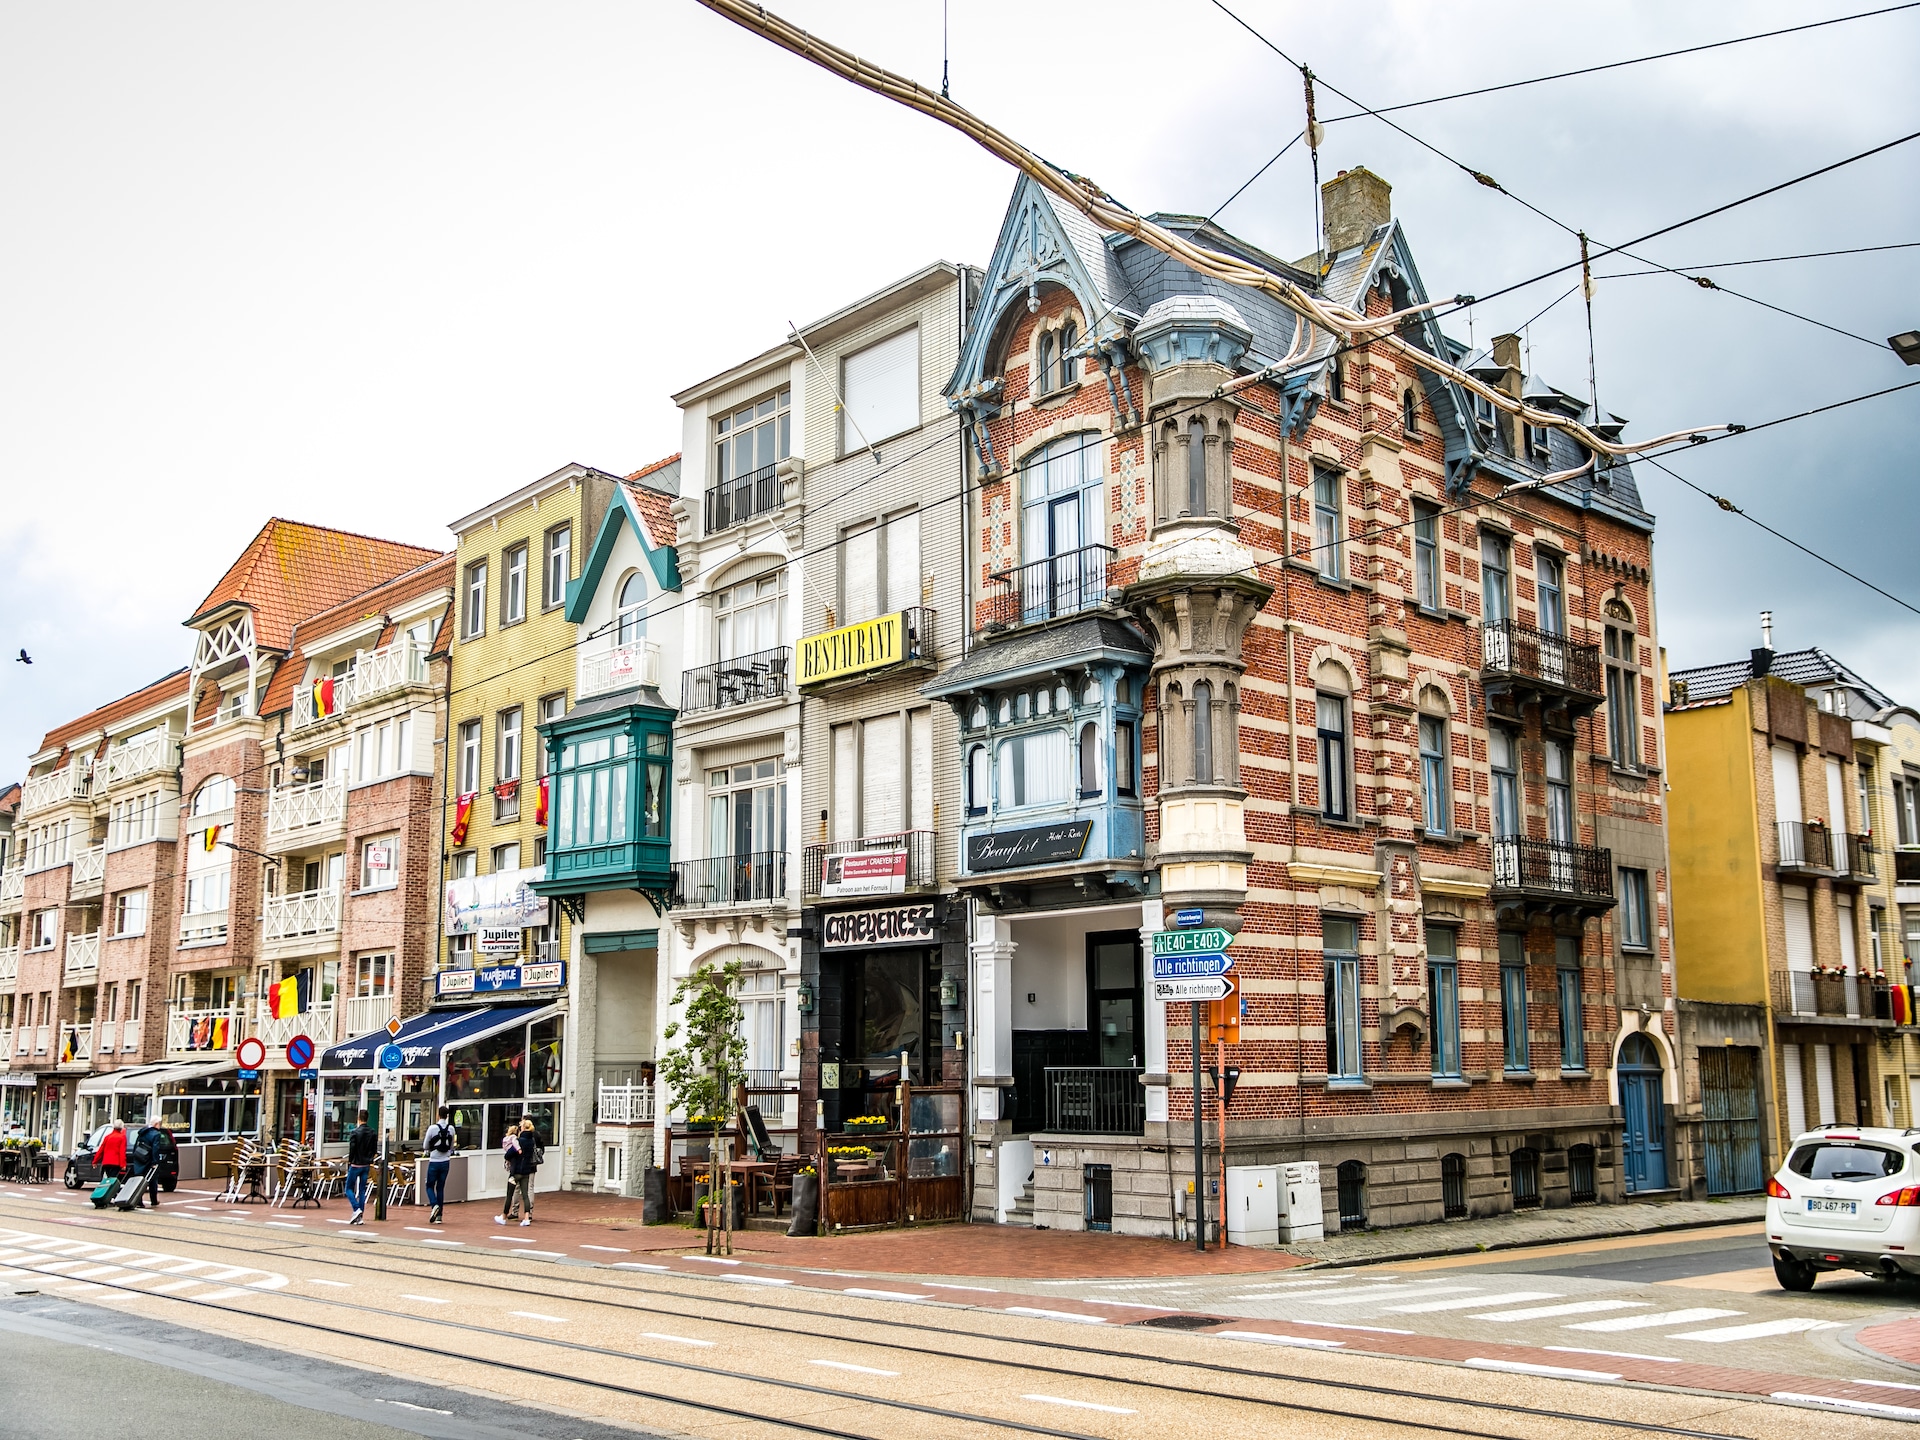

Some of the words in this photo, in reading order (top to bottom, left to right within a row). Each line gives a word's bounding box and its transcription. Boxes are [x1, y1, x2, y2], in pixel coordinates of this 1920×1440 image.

[804, 620, 894, 678] RESTAURANT
[971, 834, 1039, 863] Beaufort
[845, 859, 867, 867] Restaurant
[825, 906, 932, 943] CRAEYENEST
[482, 929, 520, 941] Jupiler
[1156, 959, 1172, 974] Alle
[1175, 957, 1220, 976] richtingen
[446, 976, 468, 987] Jupiler
[528, 968, 554, 982] Jupiler
[1175, 985, 1187, 995] Alle
[1189, 984, 1221, 996] richtingen
